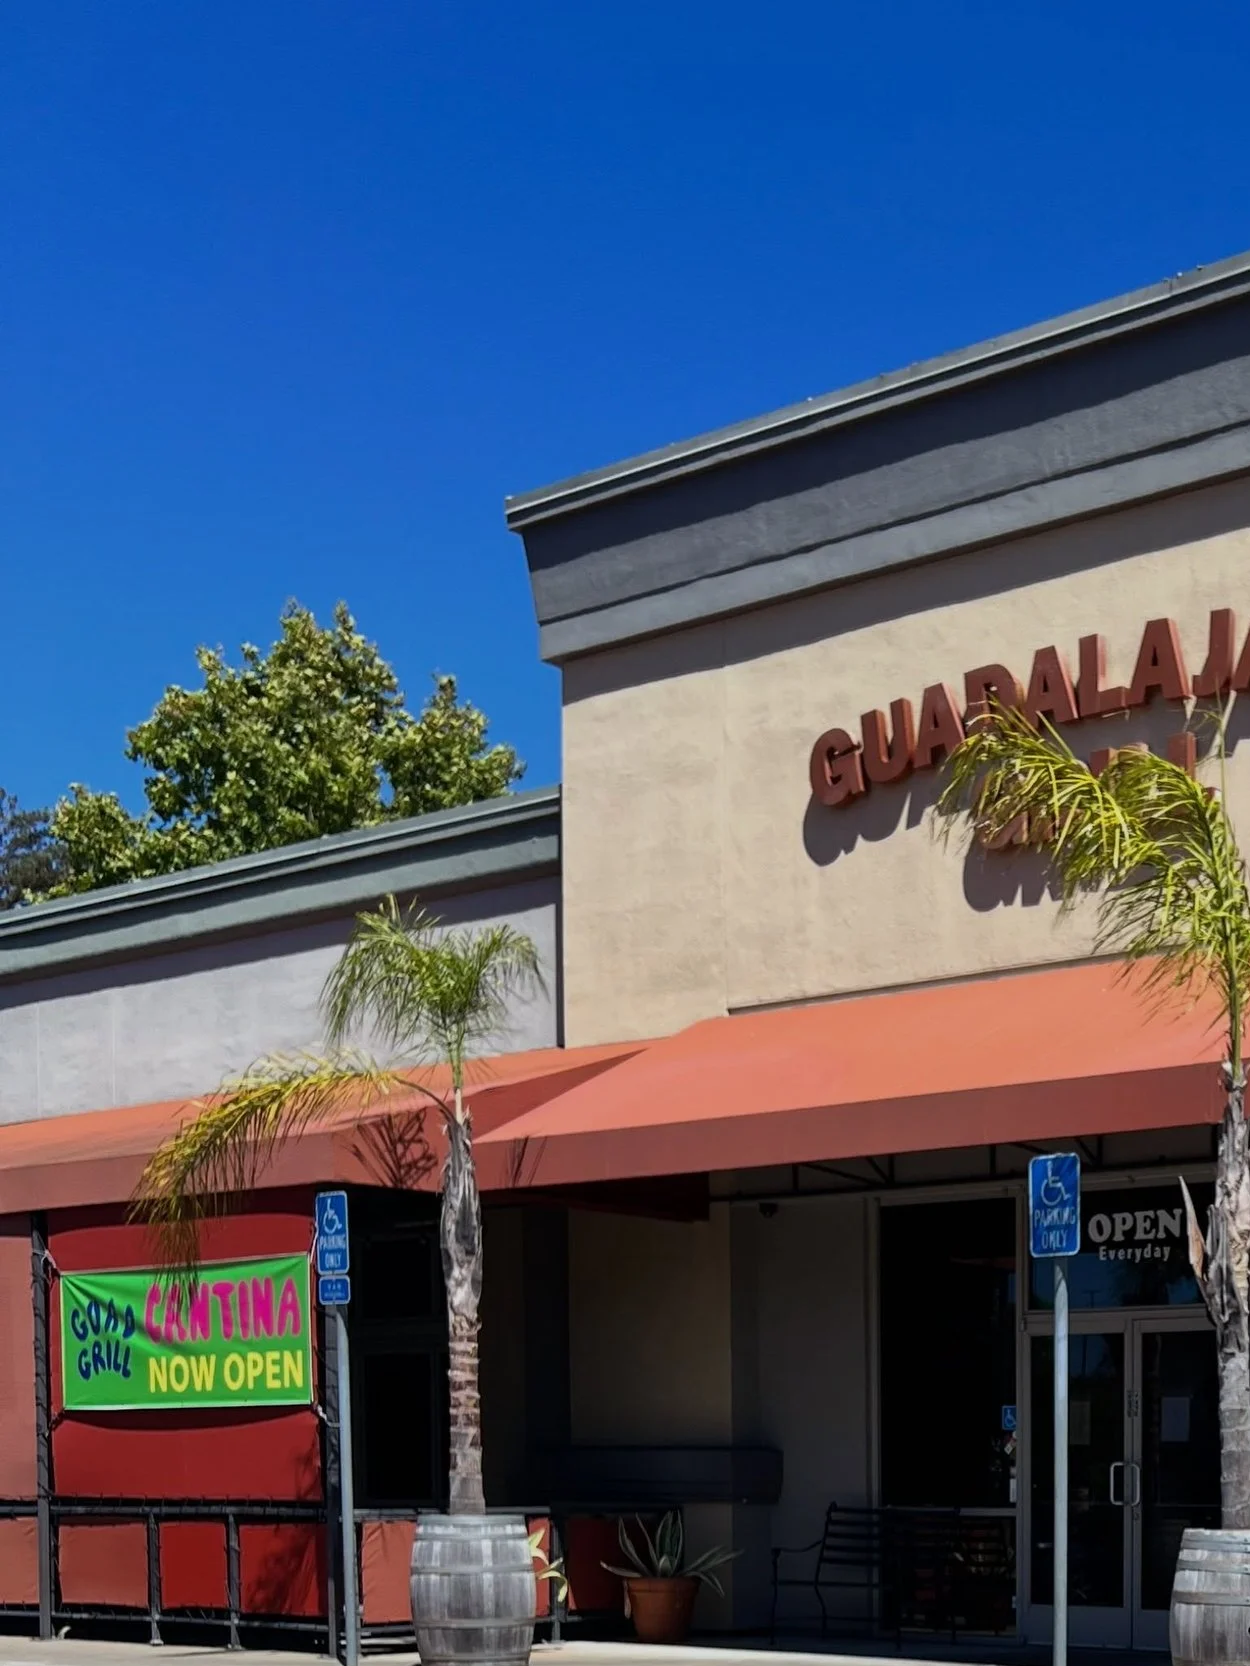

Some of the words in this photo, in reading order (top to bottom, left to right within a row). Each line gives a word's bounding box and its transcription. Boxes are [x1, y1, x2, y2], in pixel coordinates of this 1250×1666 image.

[1034, 1206, 1076, 1228] PARKING
[1088, 1208, 1182, 1243] OPEN
[1041, 1231, 1068, 1250] ONLY
[1099, 1243, 1171, 1263] Everyday
[144, 1276, 302, 1344] CANTINA
[78, 1340, 132, 1380] GRILL
[150, 1354, 216, 1393] NOW
[224, 1350, 303, 1391] OPEN
